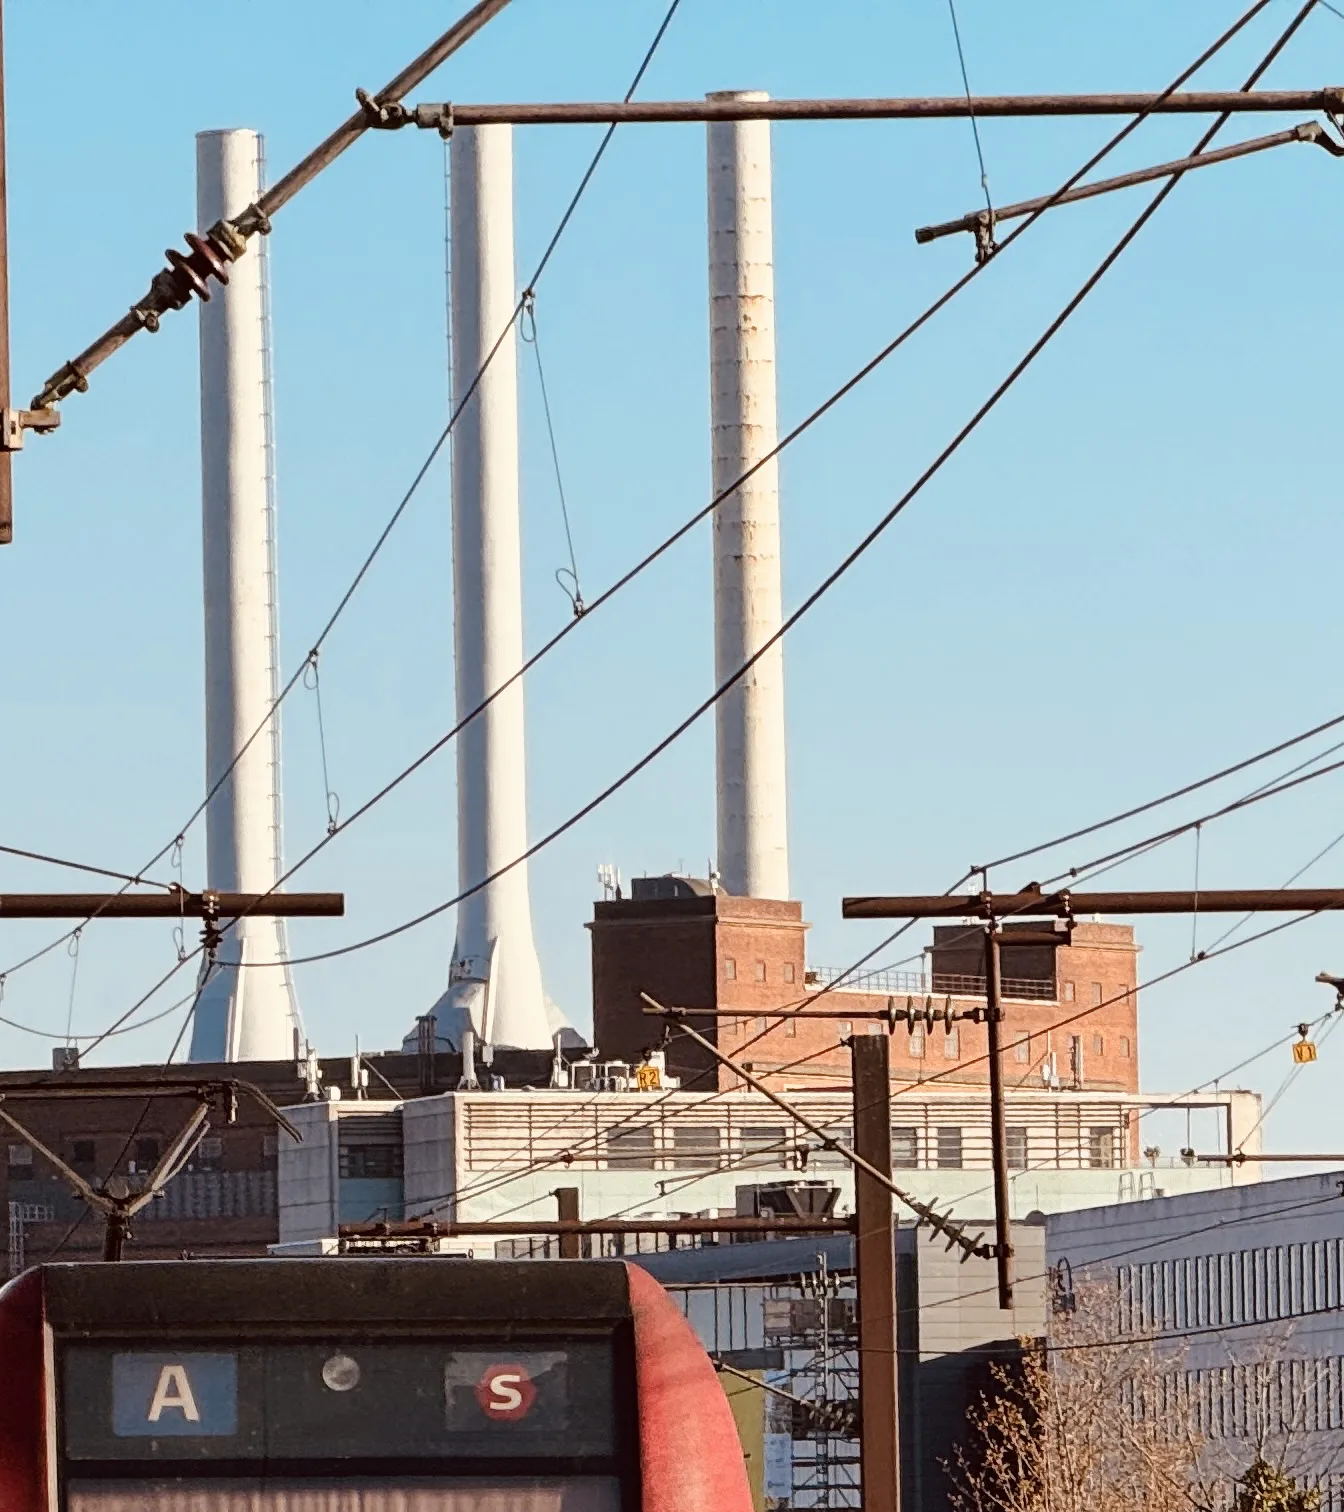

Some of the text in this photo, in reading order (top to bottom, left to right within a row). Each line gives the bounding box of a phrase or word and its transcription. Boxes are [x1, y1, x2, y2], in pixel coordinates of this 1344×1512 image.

[639, 1072, 657, 1088] R2
[147, 1365, 200, 1422] A
[489, 1374, 522, 1410] S
